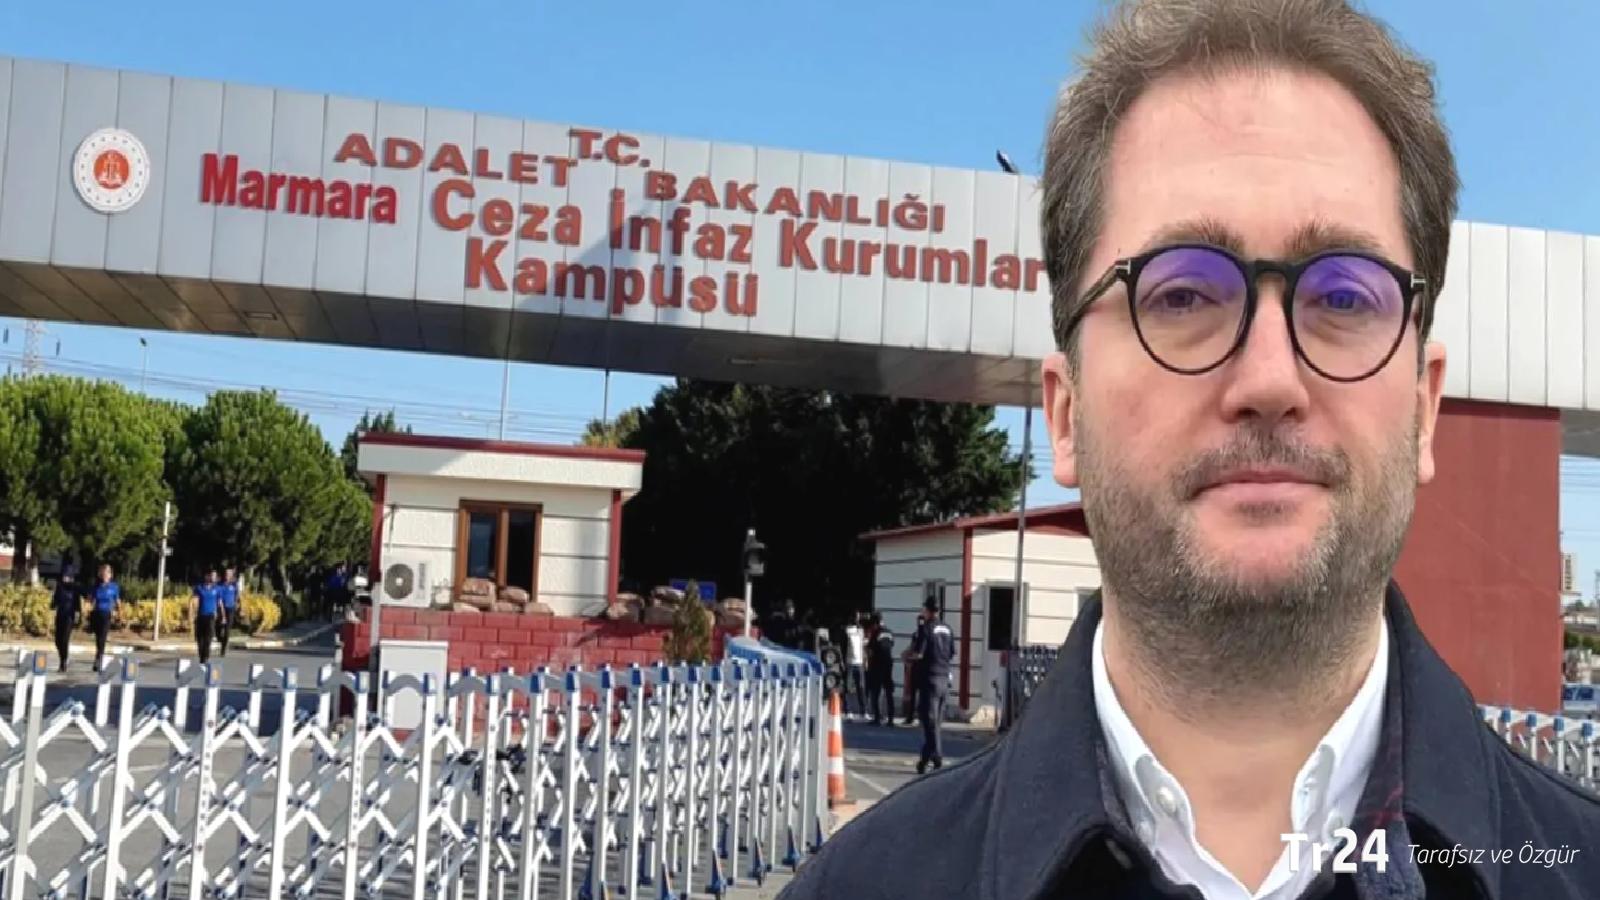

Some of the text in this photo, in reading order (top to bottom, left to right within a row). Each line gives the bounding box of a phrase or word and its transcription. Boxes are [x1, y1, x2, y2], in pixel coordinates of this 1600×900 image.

[335, 133, 946, 232] ADALET BAKANLIĞI
[567, 129, 650, 167] T.C.
[201, 152, 398, 224] Marmara
[431, 179, 582, 246] Ceza
